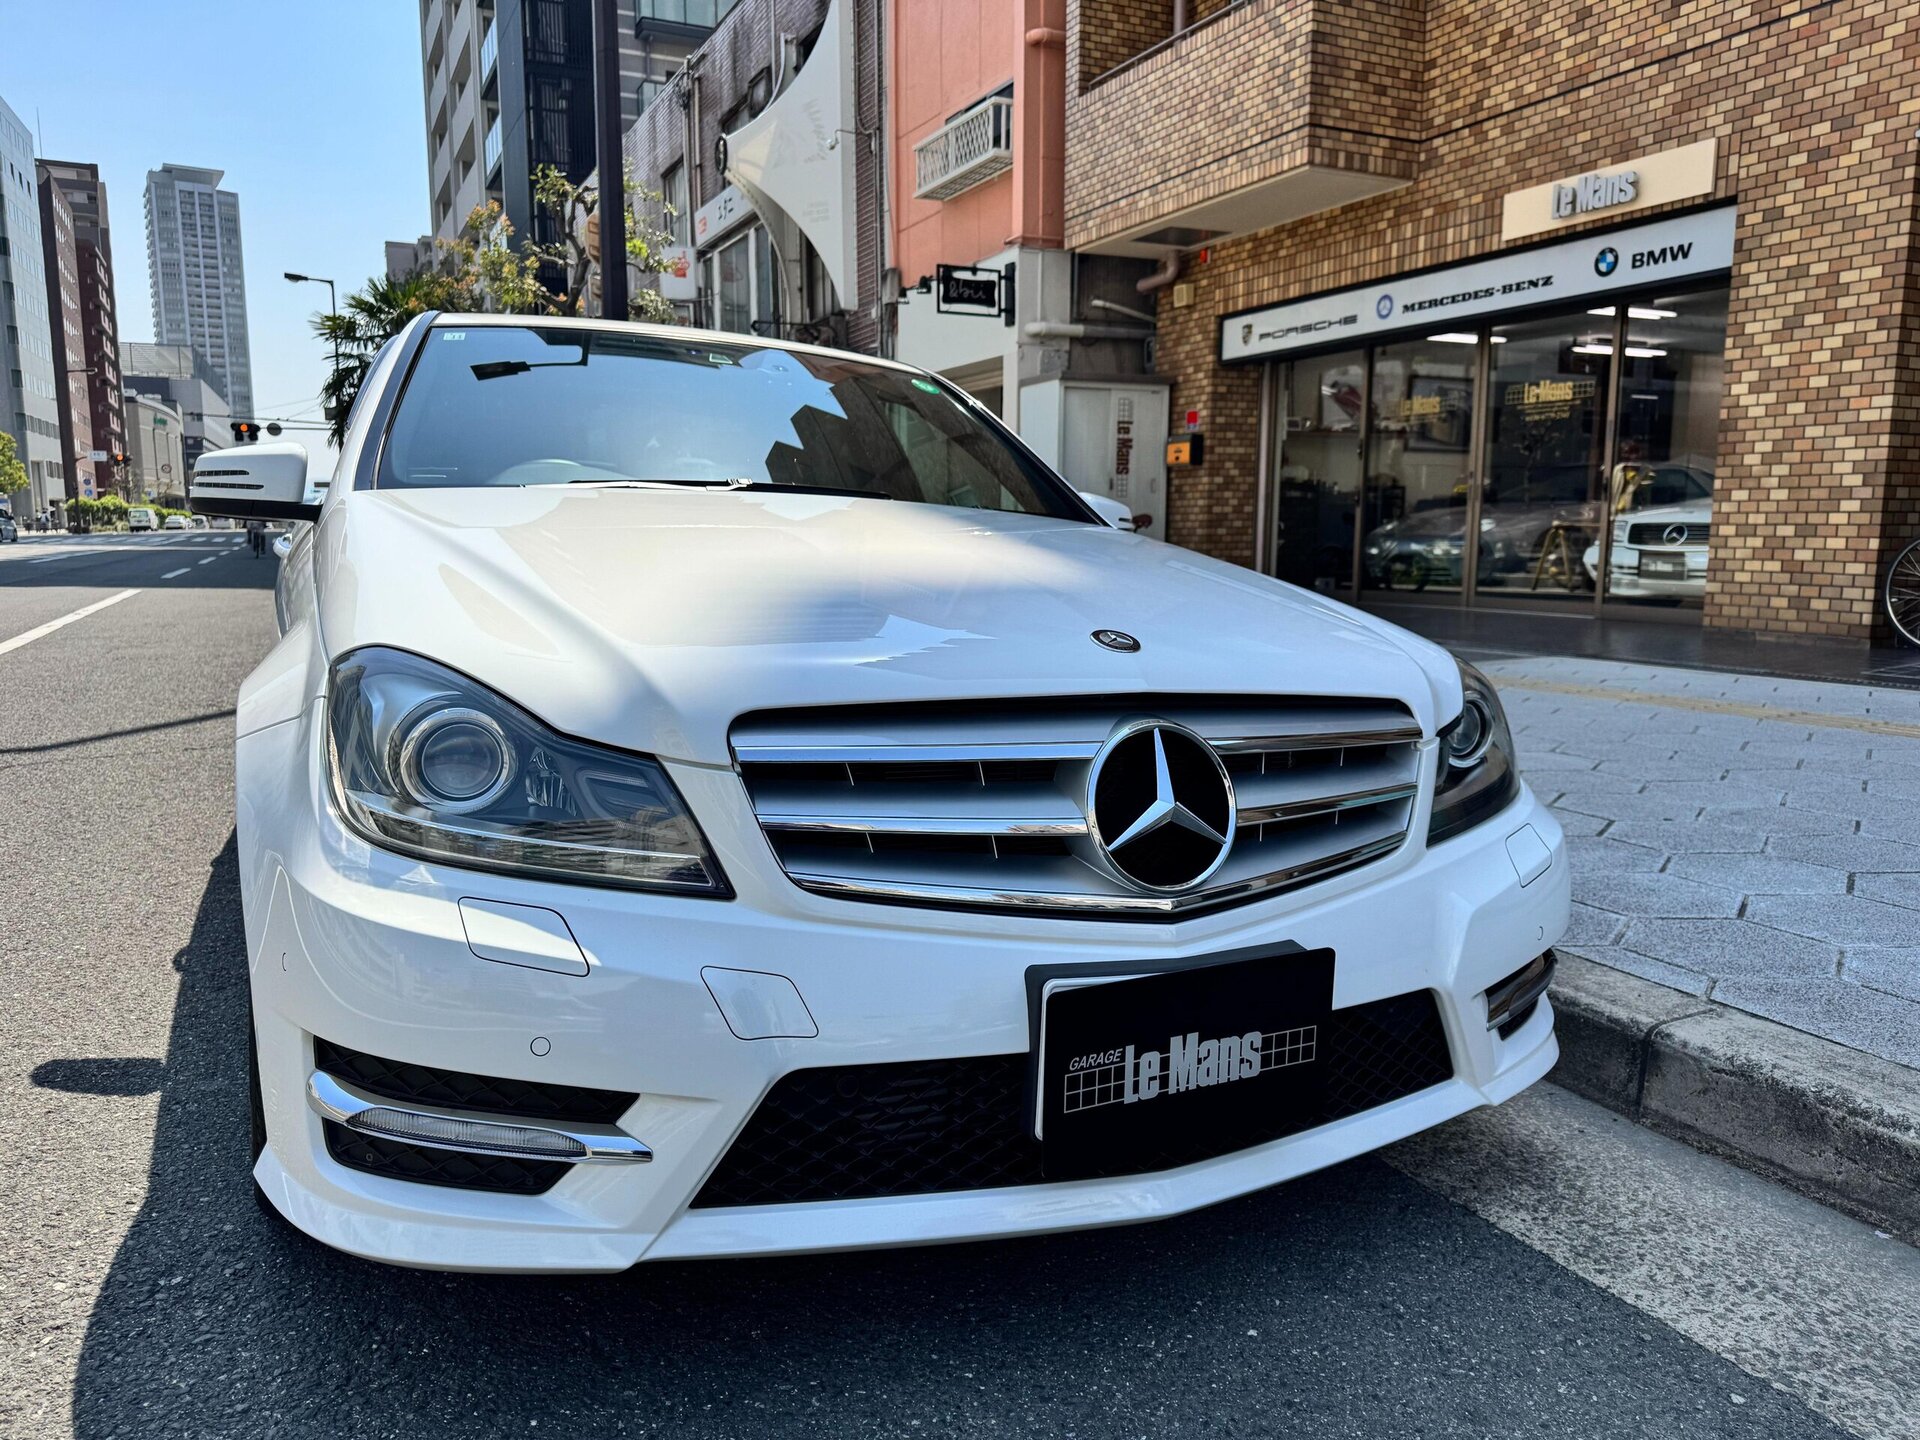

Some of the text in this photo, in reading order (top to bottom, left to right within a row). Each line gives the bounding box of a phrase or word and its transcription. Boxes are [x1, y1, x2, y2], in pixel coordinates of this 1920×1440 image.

[1552, 171, 1638, 219] Le Mans
[1630, 242, 1693, 270] BMW
[1402, 275, 1554, 314] MERCEDES-BENZ
[1258, 314, 1358, 341] PORSCHE
[1116, 438, 1133, 475] Mans
[1069, 1048, 1123, 1072] GARAGE
[1123, 1031, 1263, 1105] Le Mans
